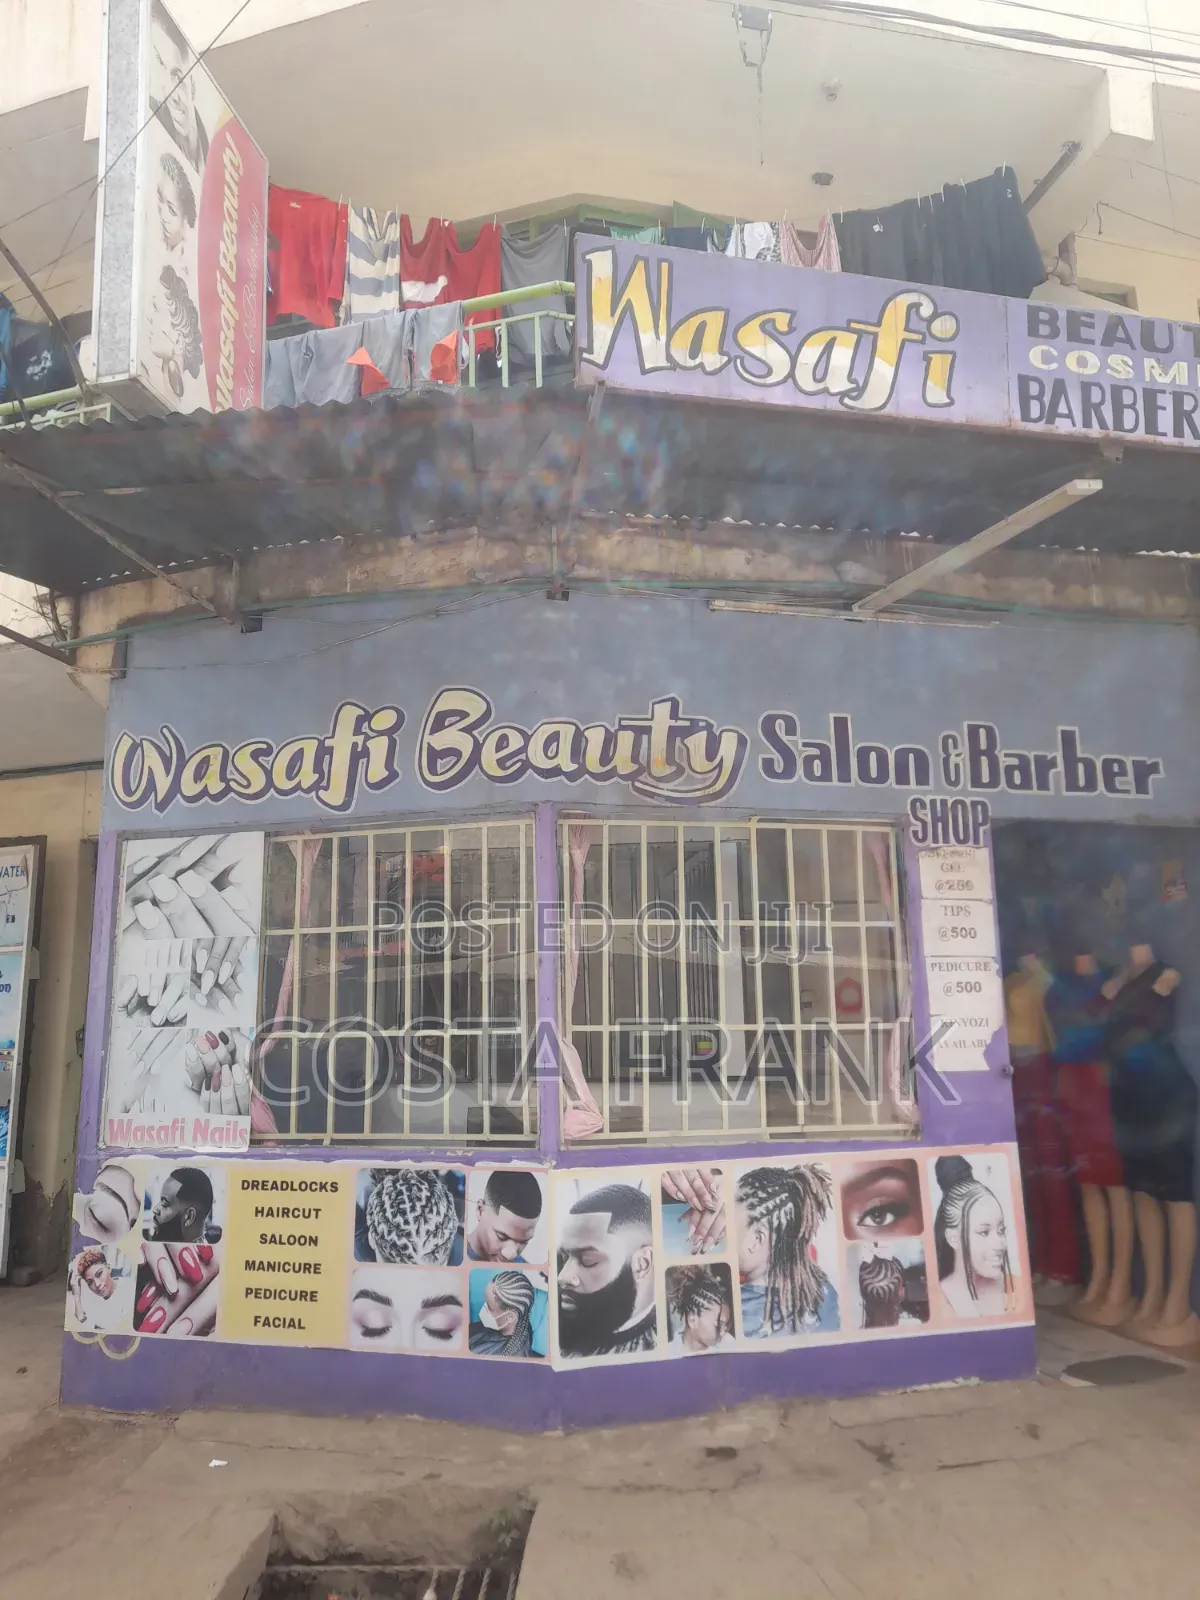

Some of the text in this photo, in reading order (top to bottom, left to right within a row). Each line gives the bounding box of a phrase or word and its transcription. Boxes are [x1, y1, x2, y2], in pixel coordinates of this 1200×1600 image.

[218, 131, 244, 284] Beauty
[579, 245, 960, 411] Wasafi
[1028, 345, 1200, 386] COSM
[1018, 373, 1200, 440] BARBER
[110, 685, 1166, 818] Wasafi Beauty Salon & Barber
[908, 796, 991, 848] SHOP
[940, 905, 971, 917] TIPS
[937, 926, 978, 942] @500
[930, 961, 992, 973] PEDICURE
[942, 981, 983, 996] @500
[108, 1118, 248, 1147] Wasafi Nails
[241, 1180, 339, 1193] DREADLOCKS
[254, 1206, 322, 1219] HAIRCUT
[259, 1233, 318, 1247] SALOON
[244, 1260, 322, 1275] MANICURE
[245, 1287, 319, 1302] PEDICURE
[253, 1315, 306, 1330] FACIAL
